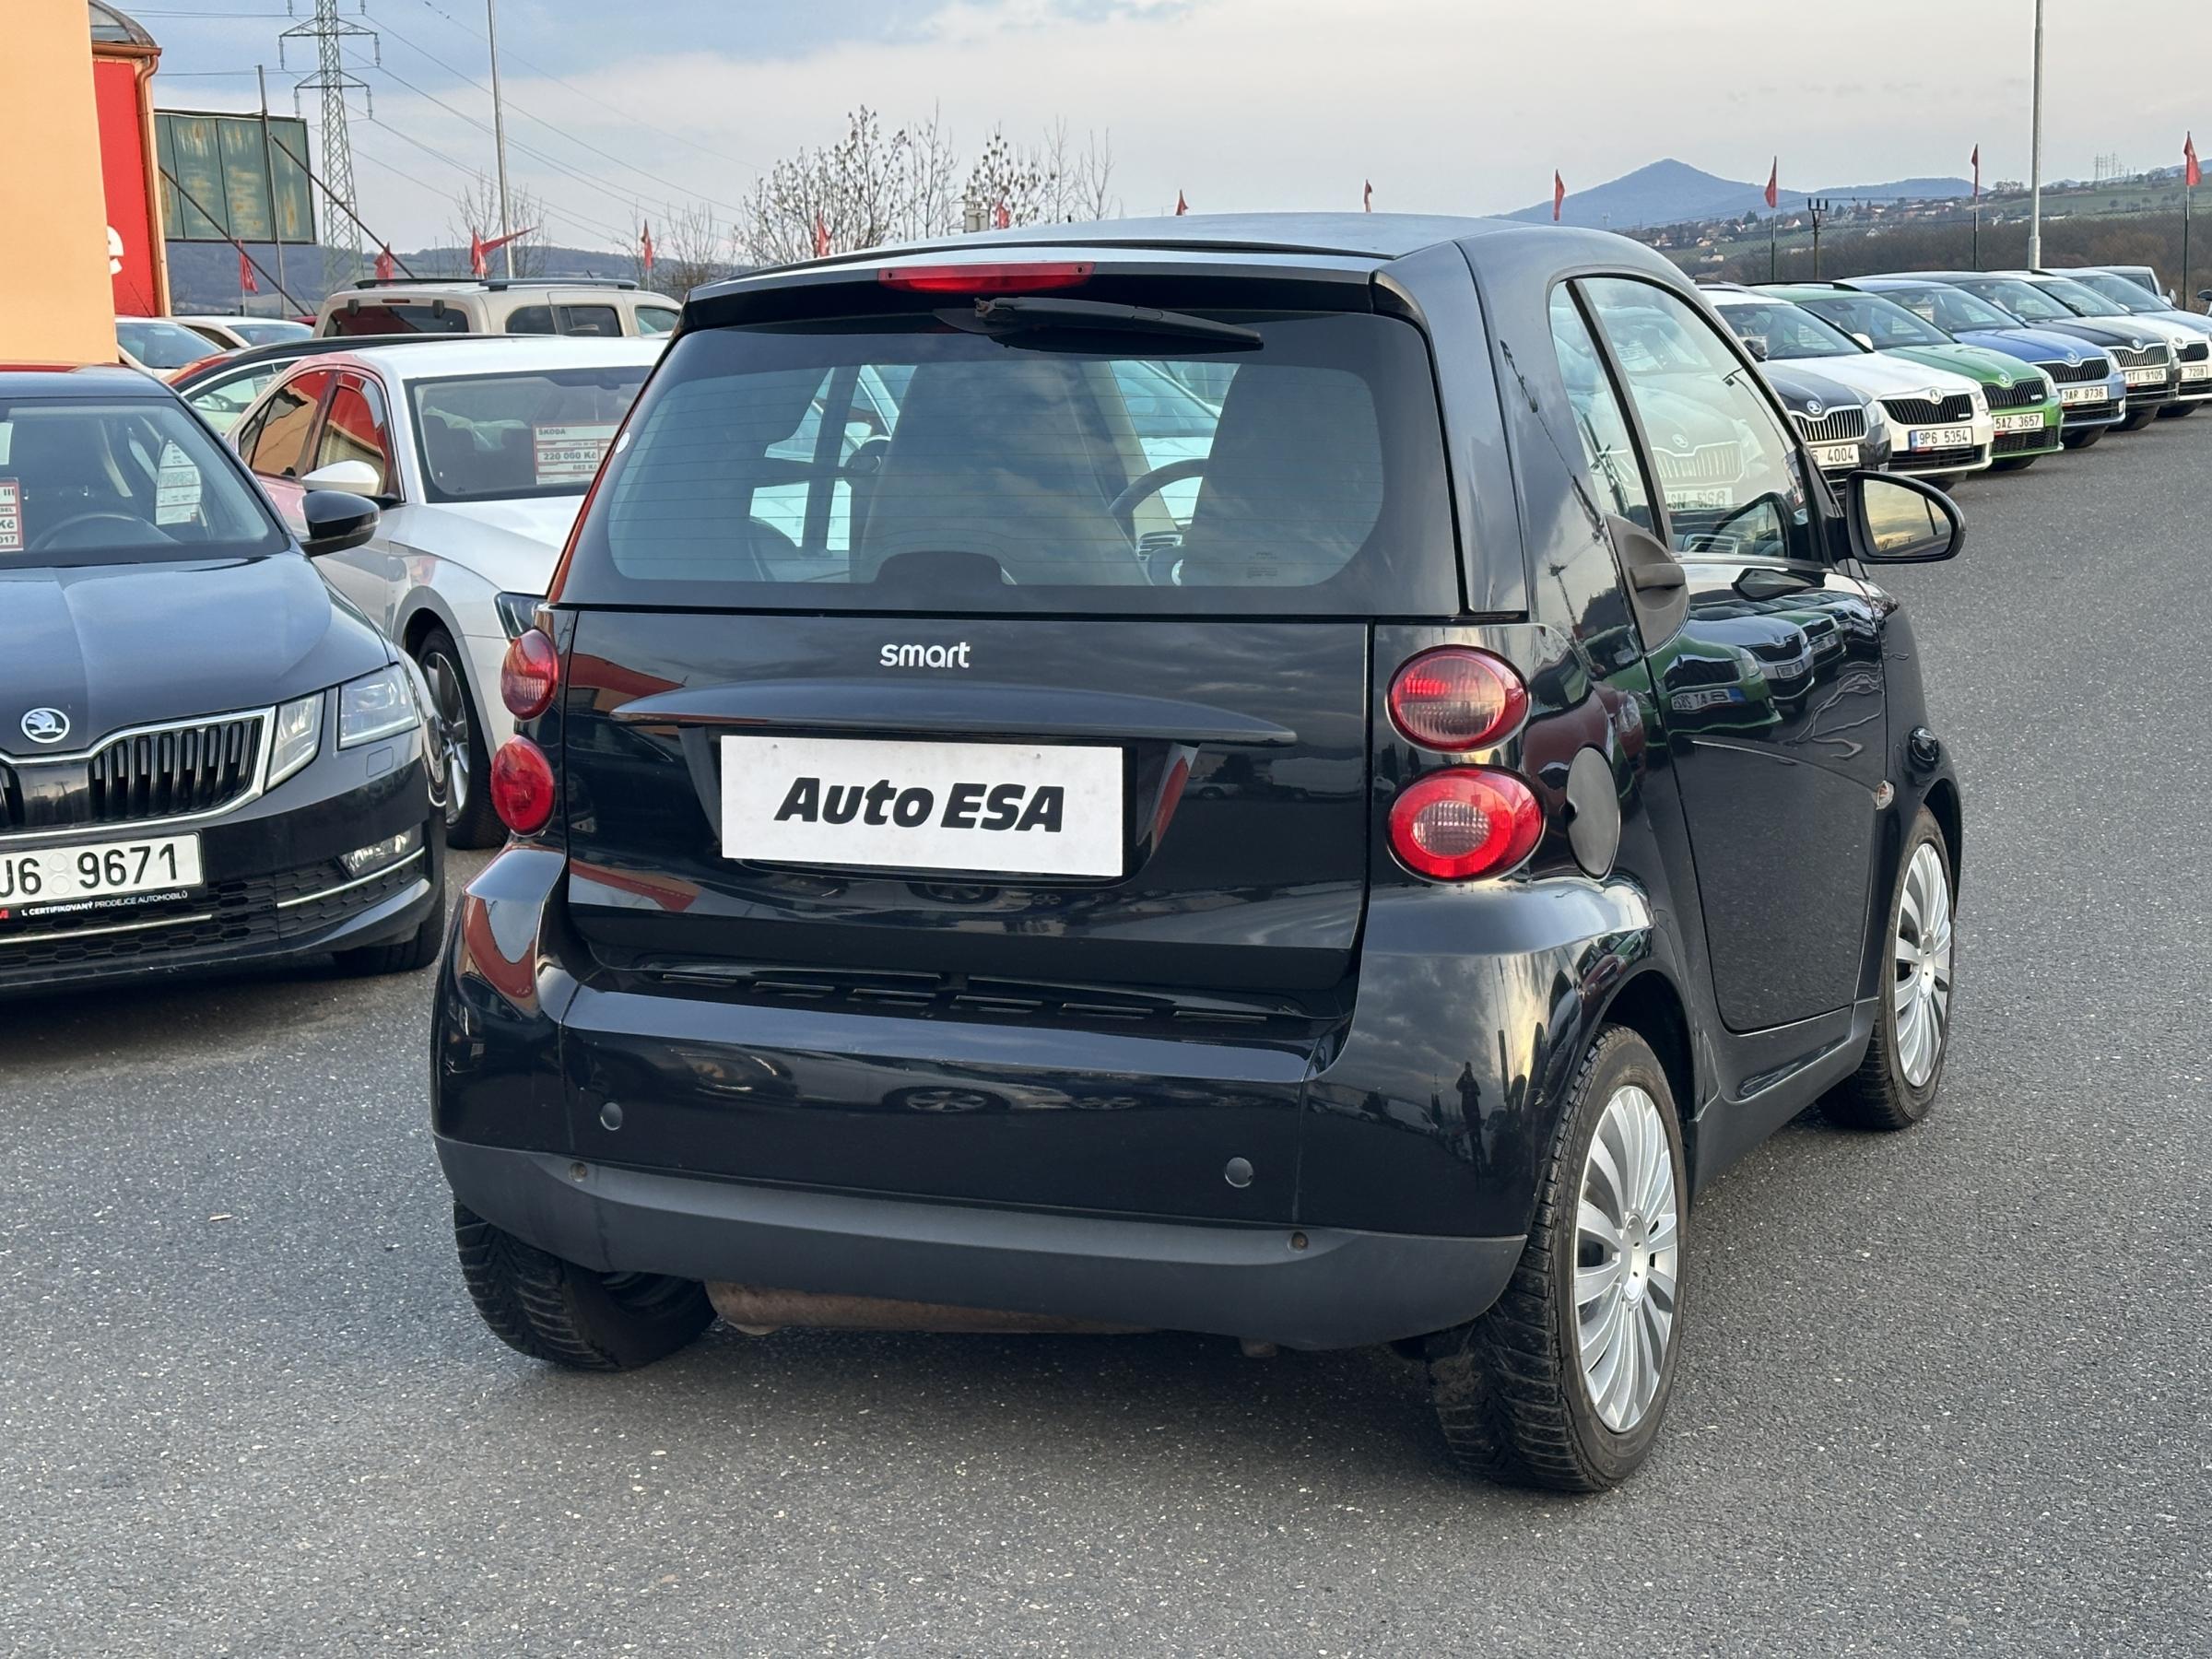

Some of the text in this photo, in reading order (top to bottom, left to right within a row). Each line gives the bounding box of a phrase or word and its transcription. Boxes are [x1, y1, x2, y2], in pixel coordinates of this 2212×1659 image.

[2145, 370, 2163, 381] 9105
[2064, 387, 2104, 401] 3AR 9736
[1995, 415, 2040, 429] 5AZ 3657
[1919, 429, 1968, 445] 9P6 5354
[543, 452, 561, 461] 220
[1827, 446, 1853, 463] 4004
[879, 641, 971, 668] smart
[774, 777, 1065, 833] Auto ESA
[76, 843, 177, 888] 9671
[29, 900, 93, 916] CERTIFIKOVANÝ
[94, 896, 136, 909] PRODEJCE
[137, 890, 188, 904] AUTOMOBILŮ
